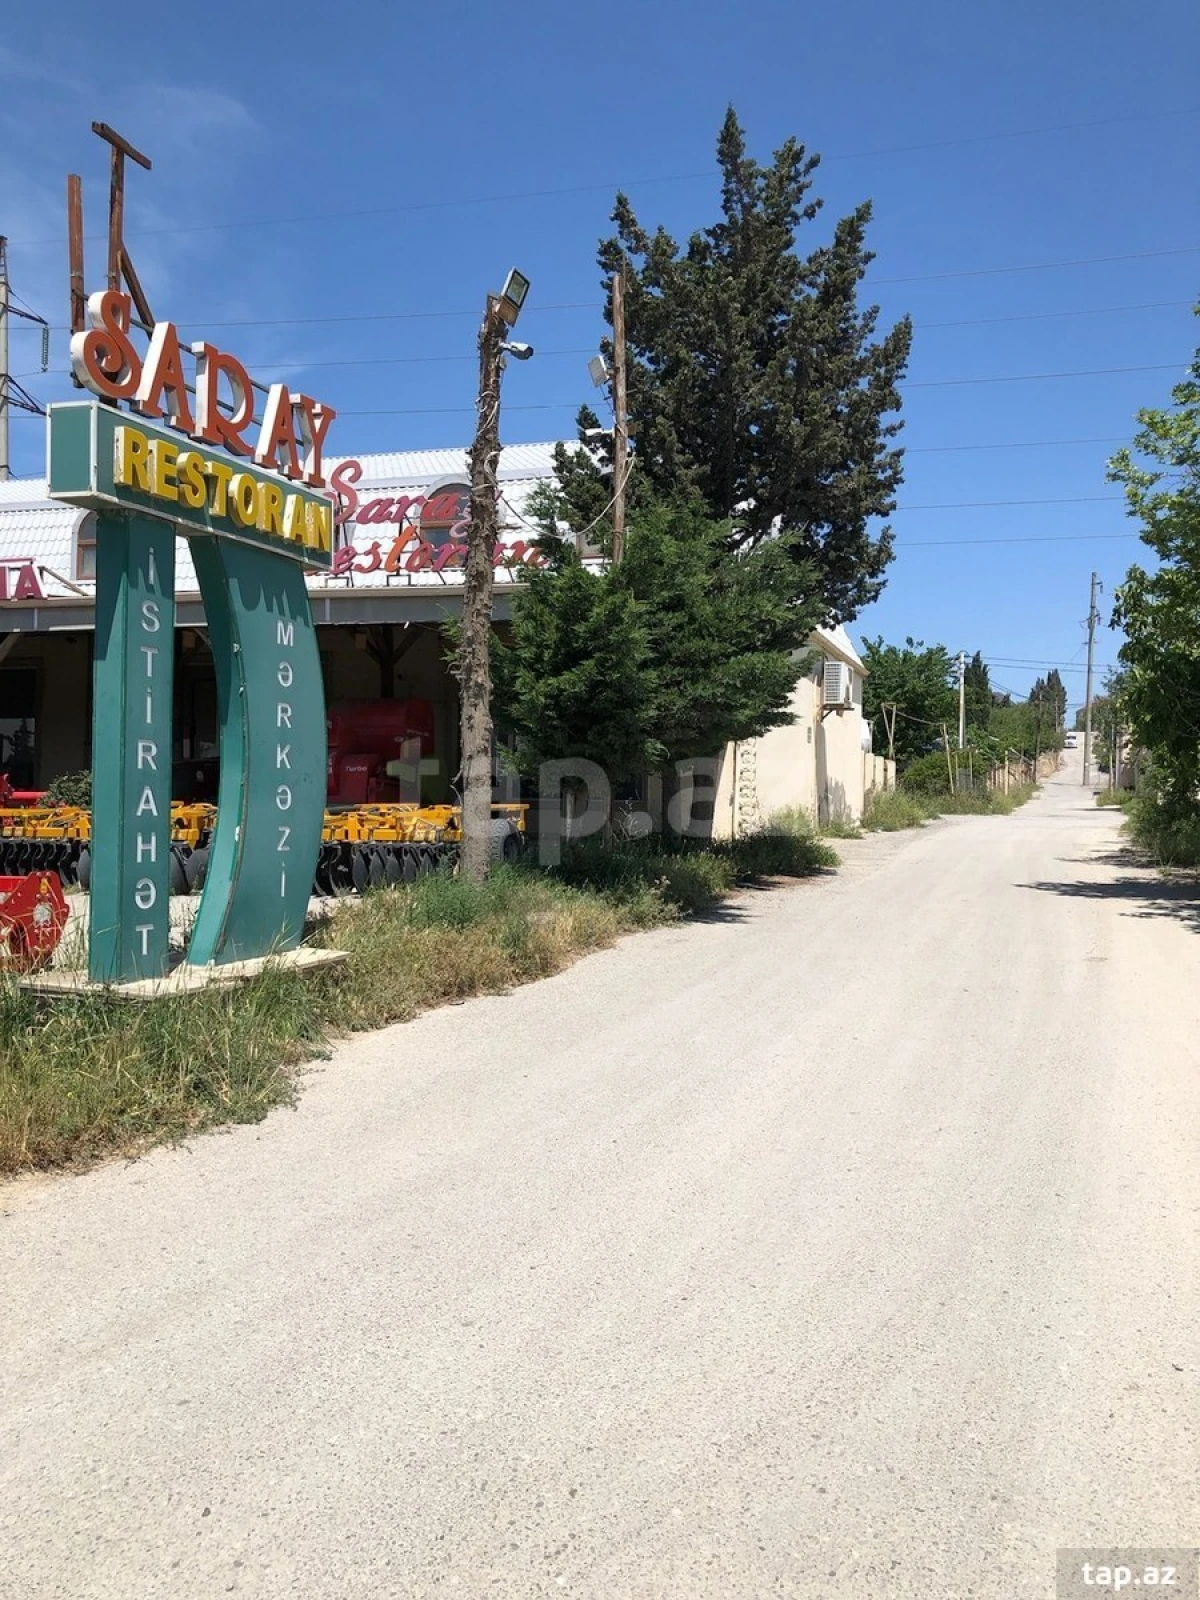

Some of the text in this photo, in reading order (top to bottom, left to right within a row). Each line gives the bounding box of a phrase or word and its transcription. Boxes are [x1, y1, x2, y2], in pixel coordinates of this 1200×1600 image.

[70, 290, 337, 488] SARAY
[114, 425, 330, 552] RESTORAN
[303, 524, 550, 575] estorn
[323, 459, 504, 538] Sara
[134, 547, 160, 956] İSTİRAHƏT
[275, 619, 295, 898] MƏRKƏZİ
